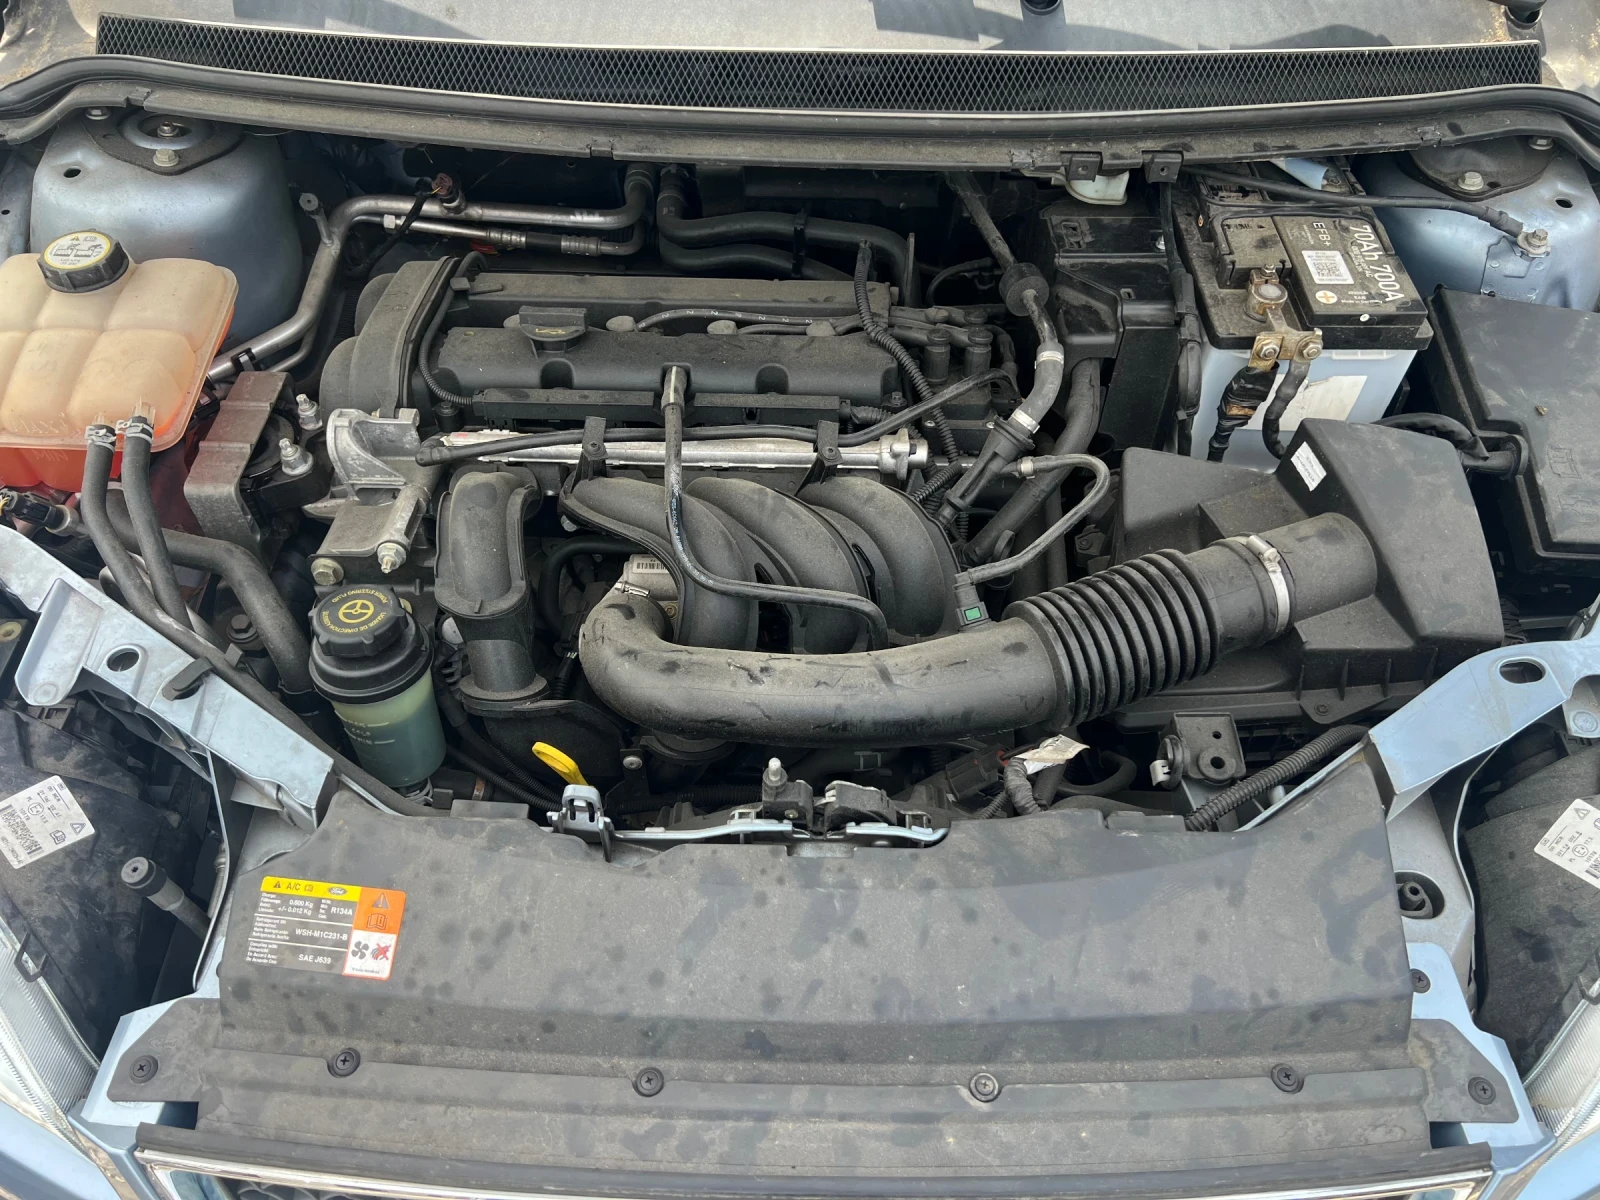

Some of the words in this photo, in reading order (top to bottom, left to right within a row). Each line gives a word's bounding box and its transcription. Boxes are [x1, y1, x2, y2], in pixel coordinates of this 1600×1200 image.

[1313, 222, 1331, 246] EFB+
[1350, 225, 1383, 260] 70Ah
[1370, 264, 1404, 302] 700A
[332, 593, 348, 603] FLUID
[286, 882, 301, 891] A/C
[330, 906, 353, 916] R134A
[295, 928, 348, 940] WSH-M1C231-B
[298, 954, 314, 962] SAE
[314, 956, 332, 964] J639
